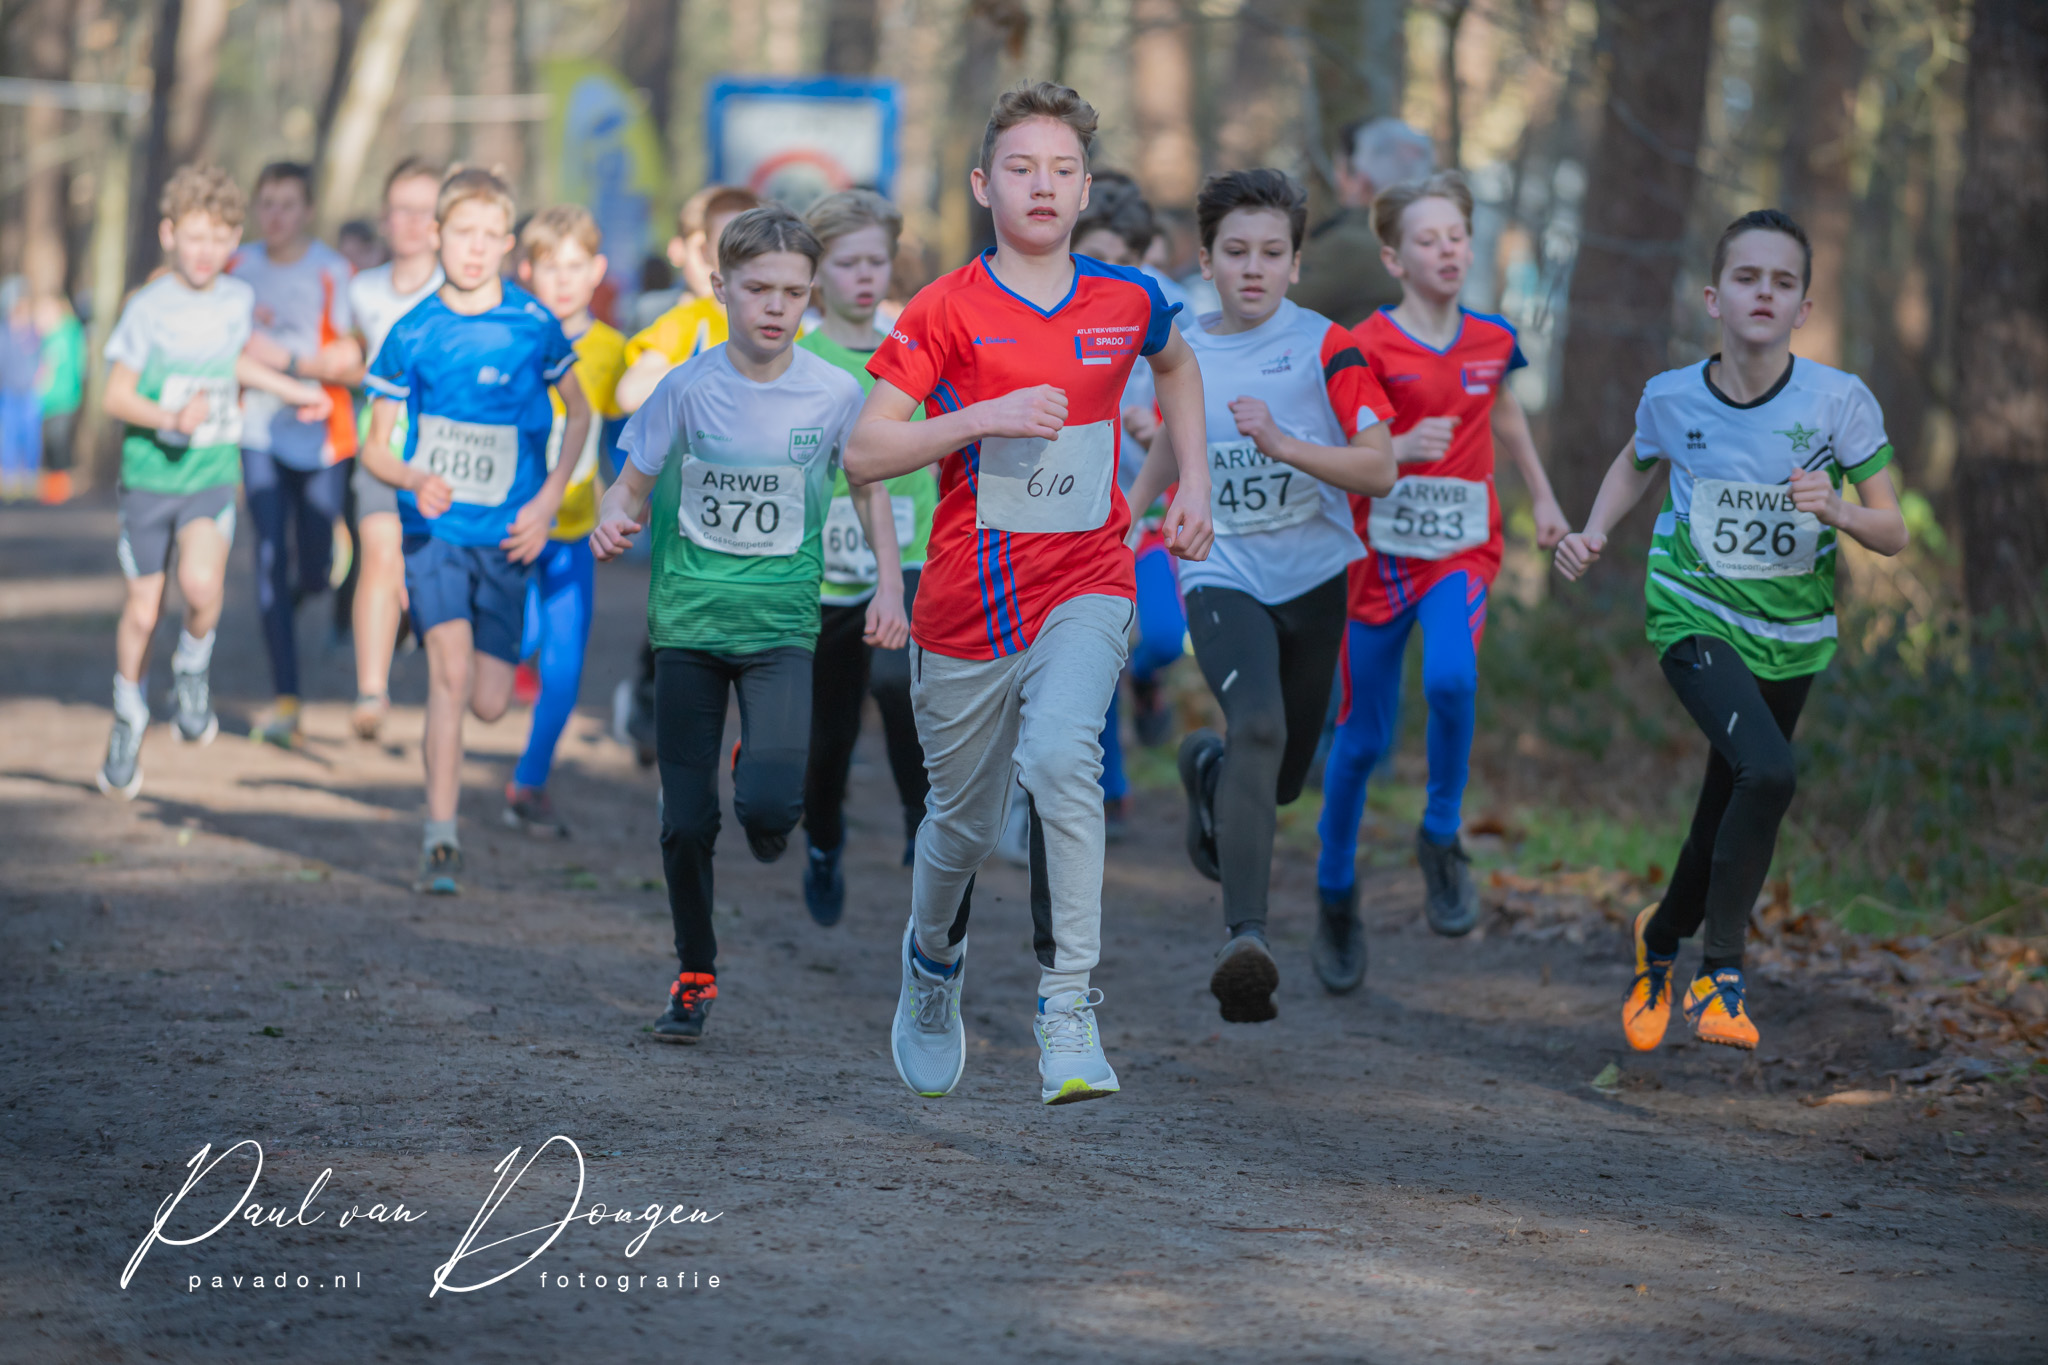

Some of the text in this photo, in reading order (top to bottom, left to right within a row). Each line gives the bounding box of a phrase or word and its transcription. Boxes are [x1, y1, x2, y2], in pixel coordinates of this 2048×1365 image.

[1096, 336, 1124, 346] SPADO
[1261, 364, 1292, 375] THOR
[794, 434, 819, 446] DJA
[429, 446, 494, 484] 689
[702, 470, 780, 493] ARWB
[1027, 467, 1075, 497] 610
[1218, 471, 1293, 513] 457
[1397, 482, 1468, 503] ARWB
[1717, 488, 1796, 512] ARWB
[701, 495, 780, 534] 370
[1392, 506, 1464, 541] 583
[703, 531, 774, 549] Crosscompetitie
[829, 526, 872, 553] 60
[1713, 516, 1796, 557] 526
